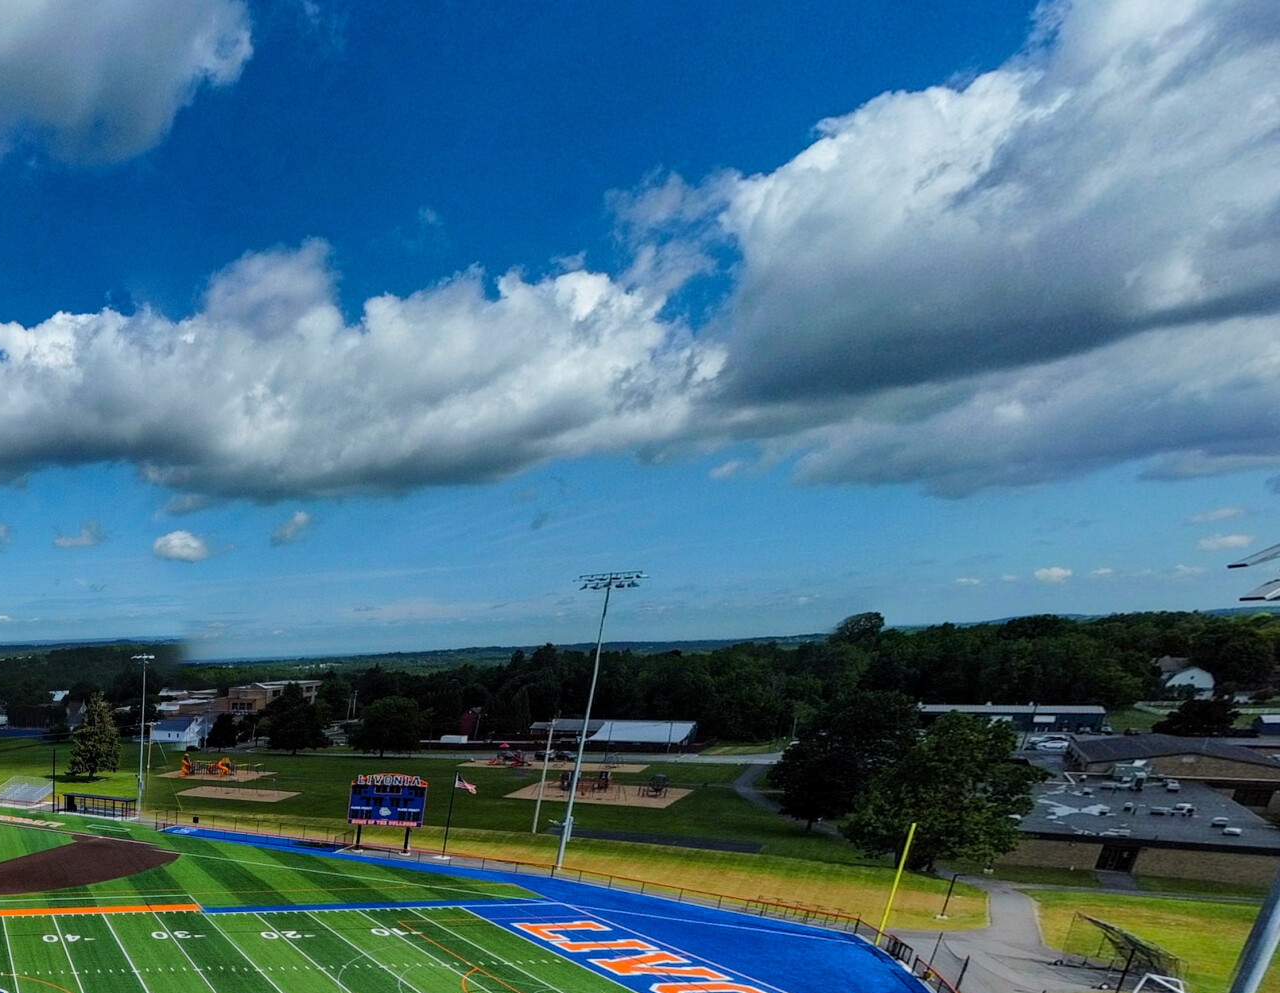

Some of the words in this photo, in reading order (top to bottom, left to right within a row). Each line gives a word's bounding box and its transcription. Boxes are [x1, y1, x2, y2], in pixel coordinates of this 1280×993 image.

[357, 774, 421, 786] LIVONIA
[151, 930, 192, 940] 30
[260, 930, 302, 940] 20
[370, 927, 410, 937] 10
[42, 934, 81, 943] 40
